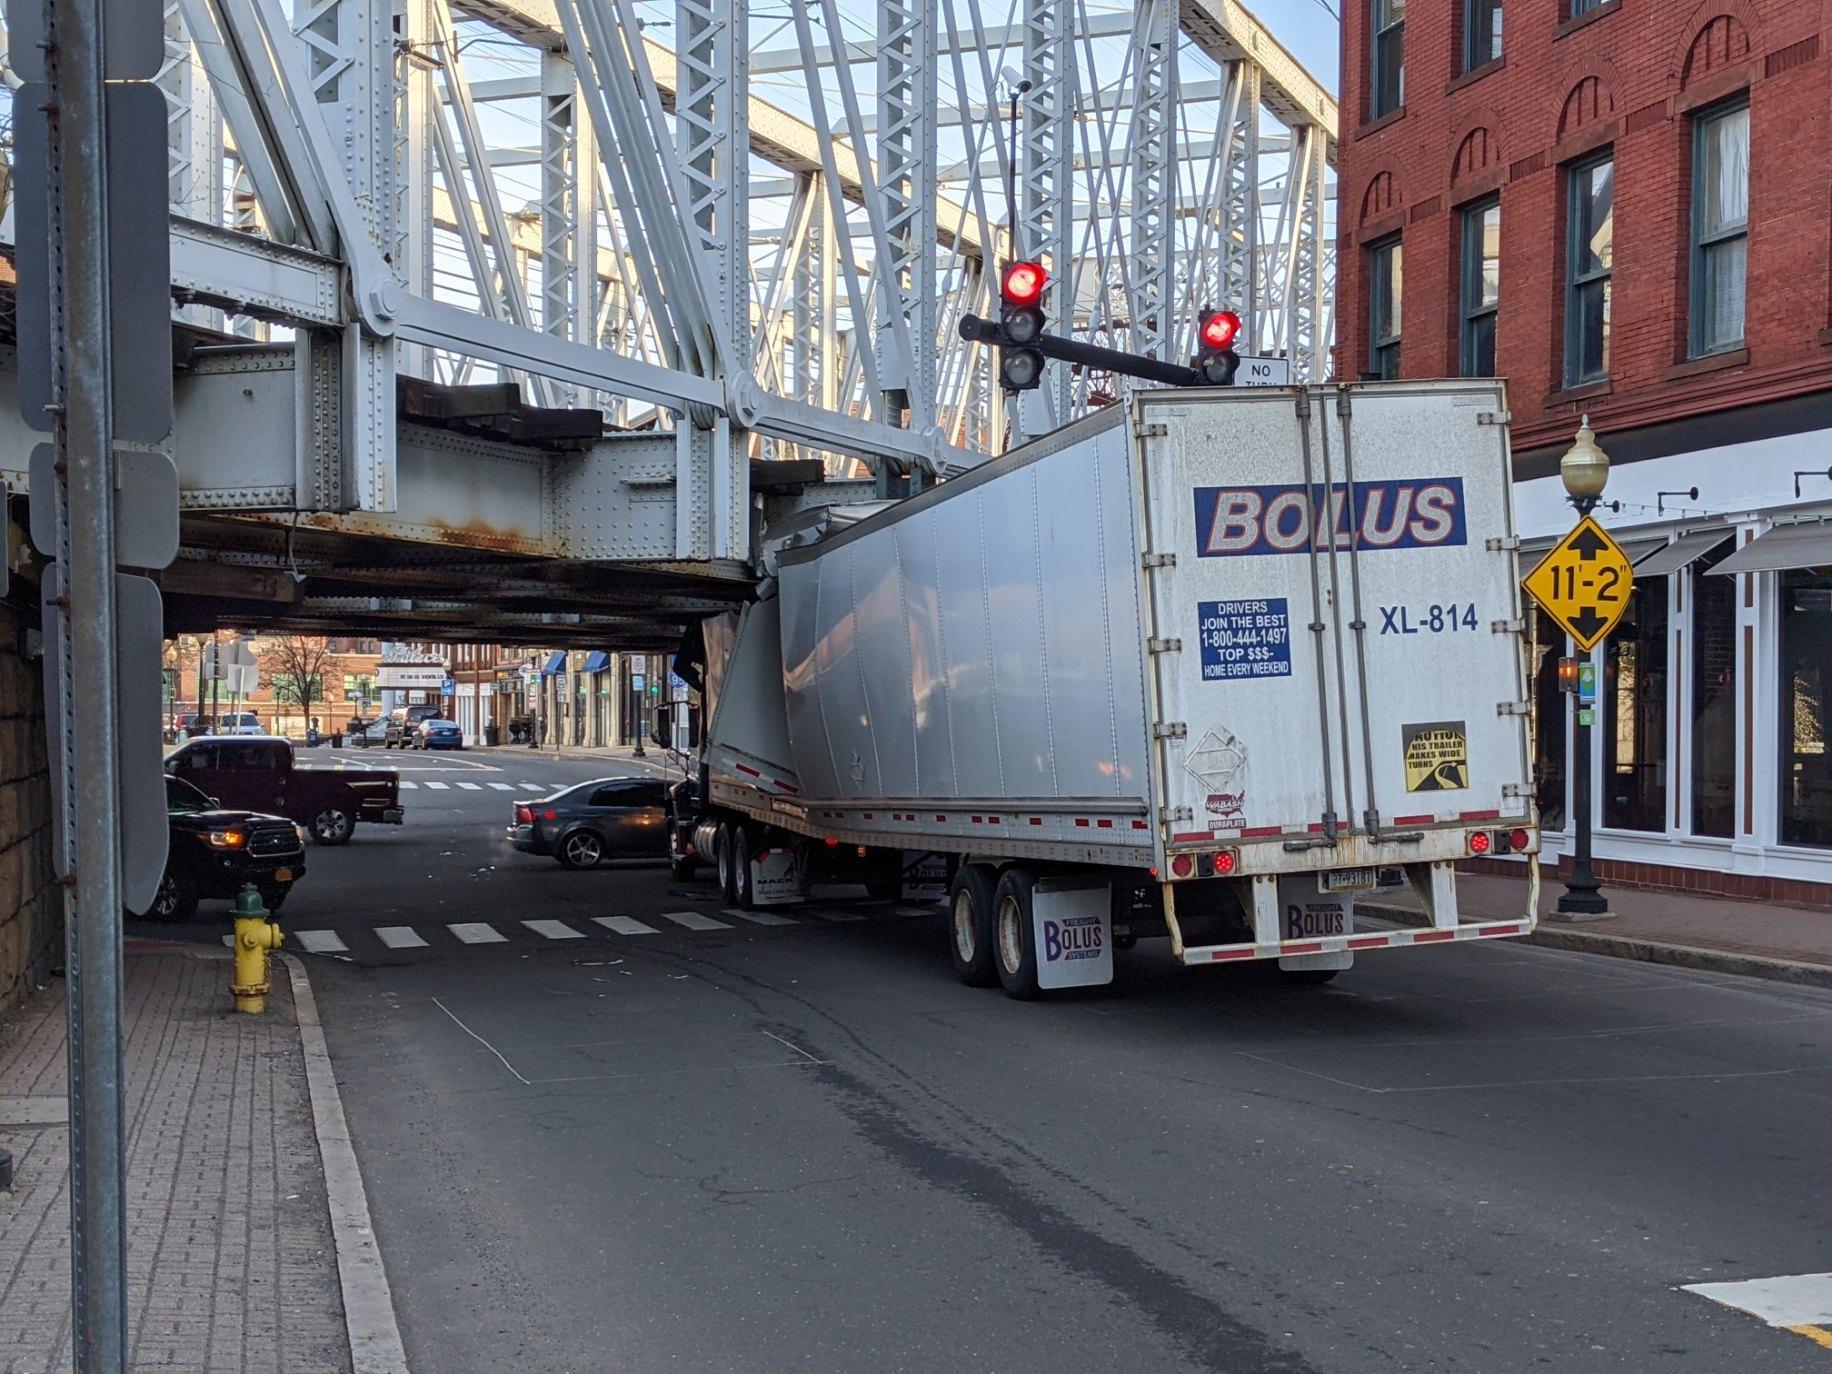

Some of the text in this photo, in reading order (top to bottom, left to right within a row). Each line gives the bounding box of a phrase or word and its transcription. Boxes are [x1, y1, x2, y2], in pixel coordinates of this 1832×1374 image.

[1251, 364, 1271, 377] NO
[1206, 484, 1457, 552] BOLUS
[1217, 601, 1268, 615] DRIVERS
[1201, 614, 1286, 630] JOIN THE BEST
[1379, 603, 1479, 635] XL-814
[1202, 627, 1287, 648] 1-800-444-1497
[1217, 648, 1244, 661] TOP
[1204, 660, 1289, 677] HOME EVERY WEEKEND
[1410, 731, 1464, 741] AUTION
[1411, 741, 1463, 751] HIS TRAILER
[1408, 750, 1461, 760] MAKES WIDE
[1408, 760, 1434, 769] TURNS
[1209, 818, 1246, 830] DURAPLATE
[1287, 904, 1344, 939] BOLUS
[1044, 920, 1102, 962] BOLUS
